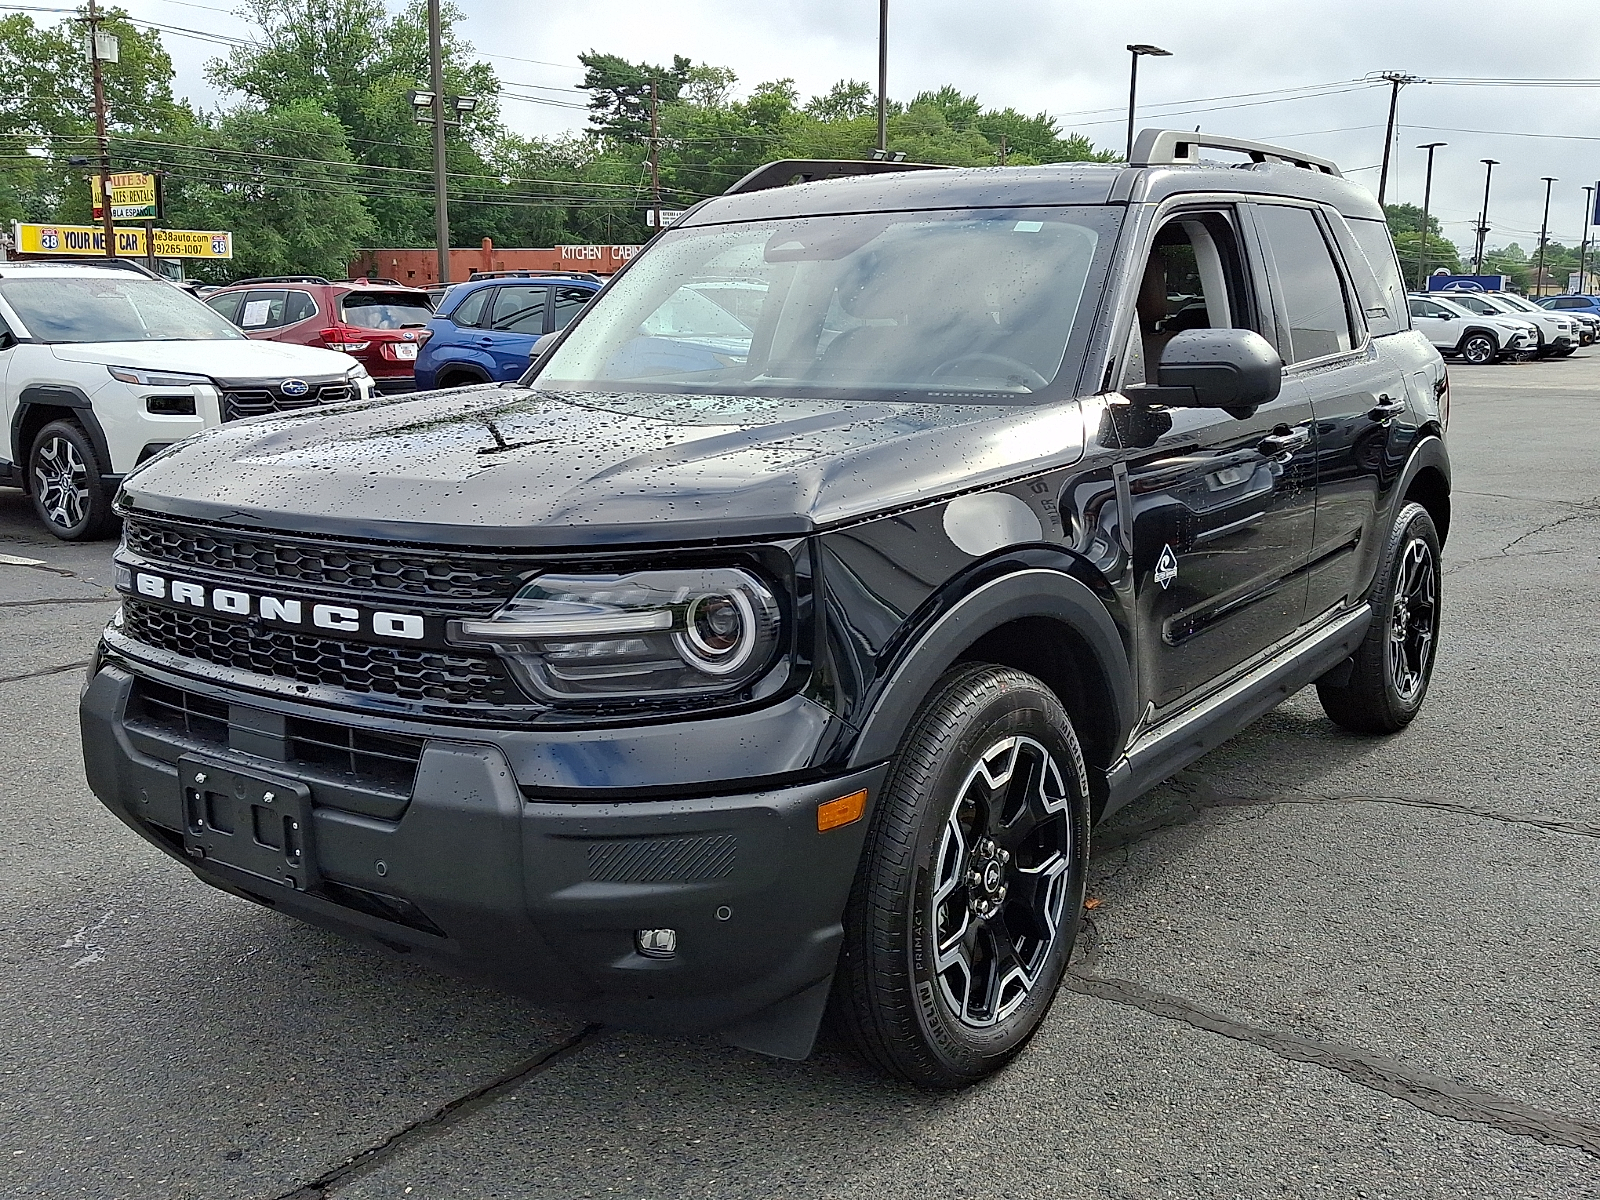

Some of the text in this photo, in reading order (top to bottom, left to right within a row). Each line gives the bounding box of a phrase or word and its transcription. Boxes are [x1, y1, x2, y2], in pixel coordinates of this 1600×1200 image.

[136, 174, 148, 185] 38
[129, 189, 154, 203] RENTALS
[42, 235, 58, 248] 38
[63, 231, 90, 249] YOUR
[119, 234, 138, 251] CAR
[212, 241, 226, 253] 38
[561, 246, 602, 260] KITCHEN
[136, 572, 424, 640] BRONCO
[1060, 721, 1089, 796] MICHELIN
[915, 904, 924, 972] PRIMACY
